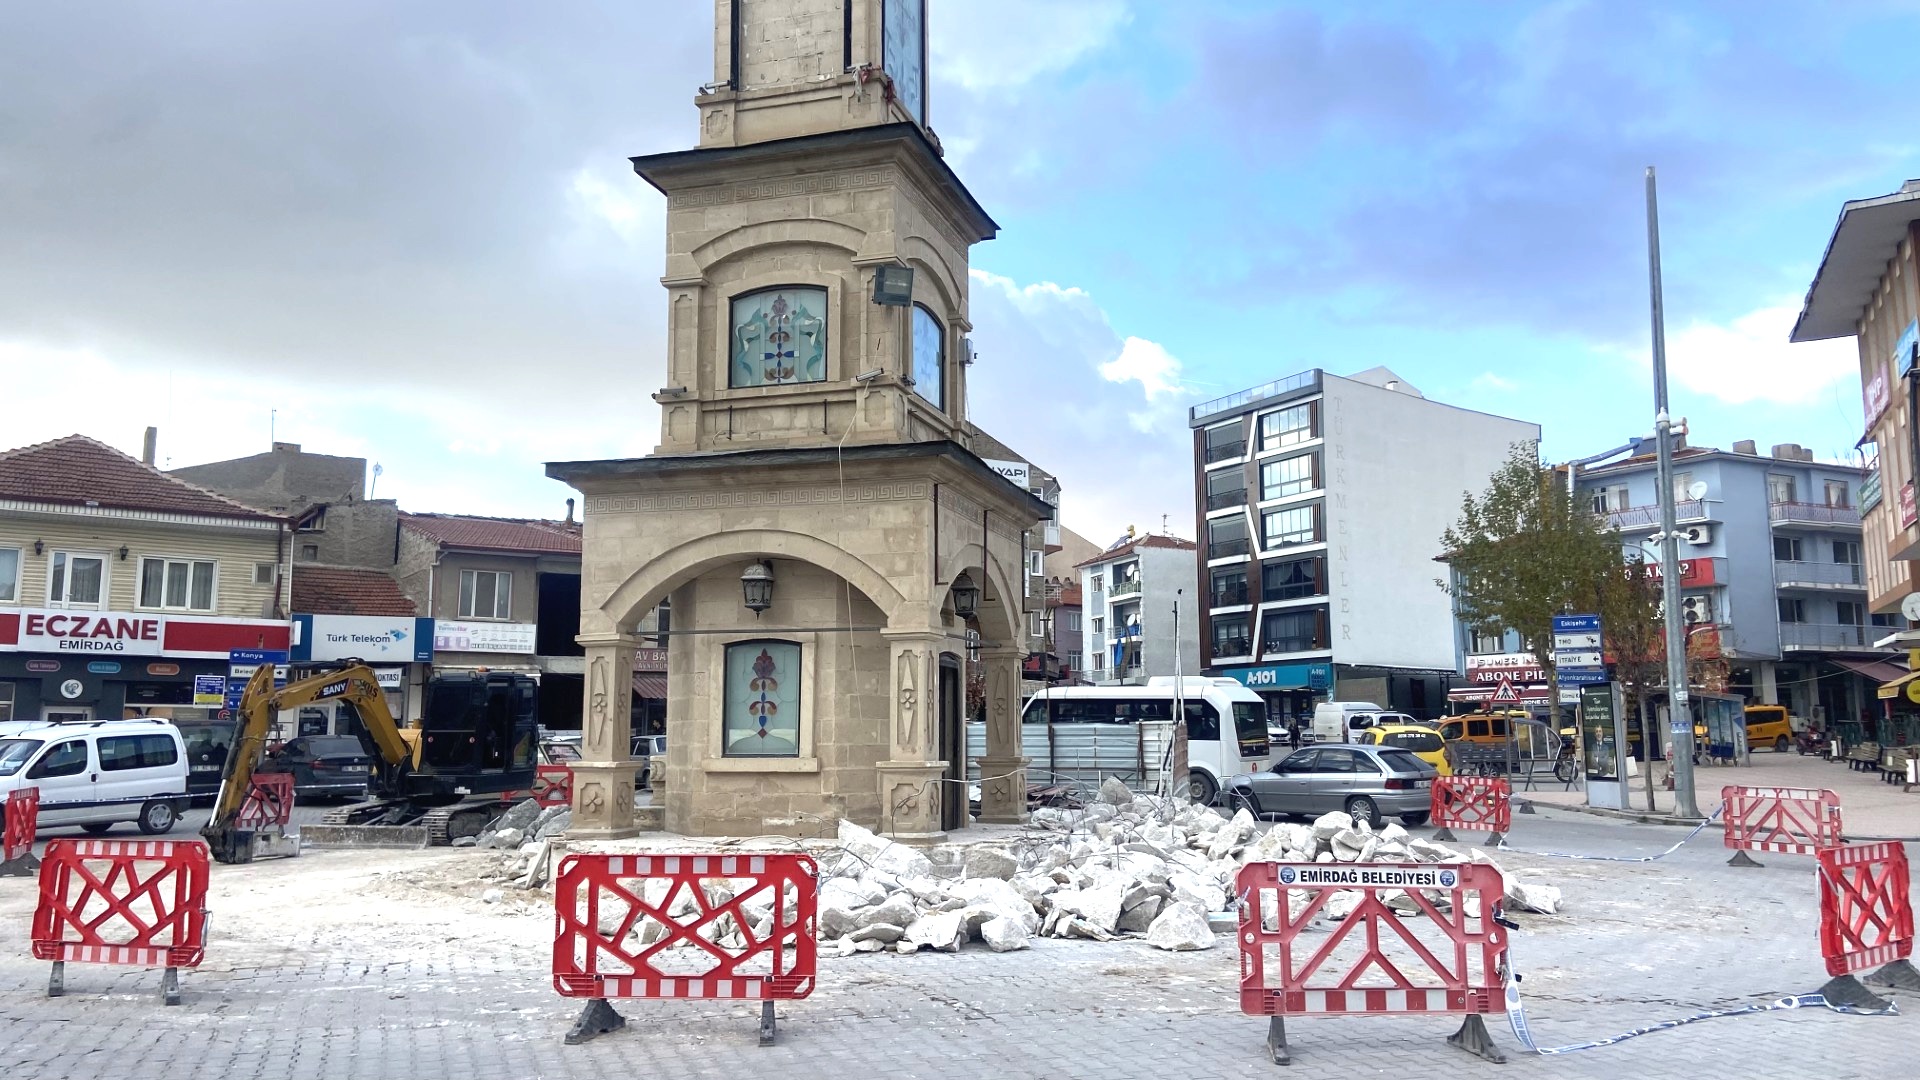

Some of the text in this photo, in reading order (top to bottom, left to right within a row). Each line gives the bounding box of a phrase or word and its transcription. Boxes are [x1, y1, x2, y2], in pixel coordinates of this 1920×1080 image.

[26, 614, 158, 640] ECZANE
[326, 633, 391, 643] Türk Telekom
[59, 639, 124, 651] EMİRDAĞ
[241, 652, 264, 660] Konya
[375, 673, 400, 682] OKTASI
[1476, 668, 1547, 682] ABONE PİD
[323, 681, 347, 696] SANY
[1300, 868, 1436, 885] EMİRDAĞ BELEDİYESİ
